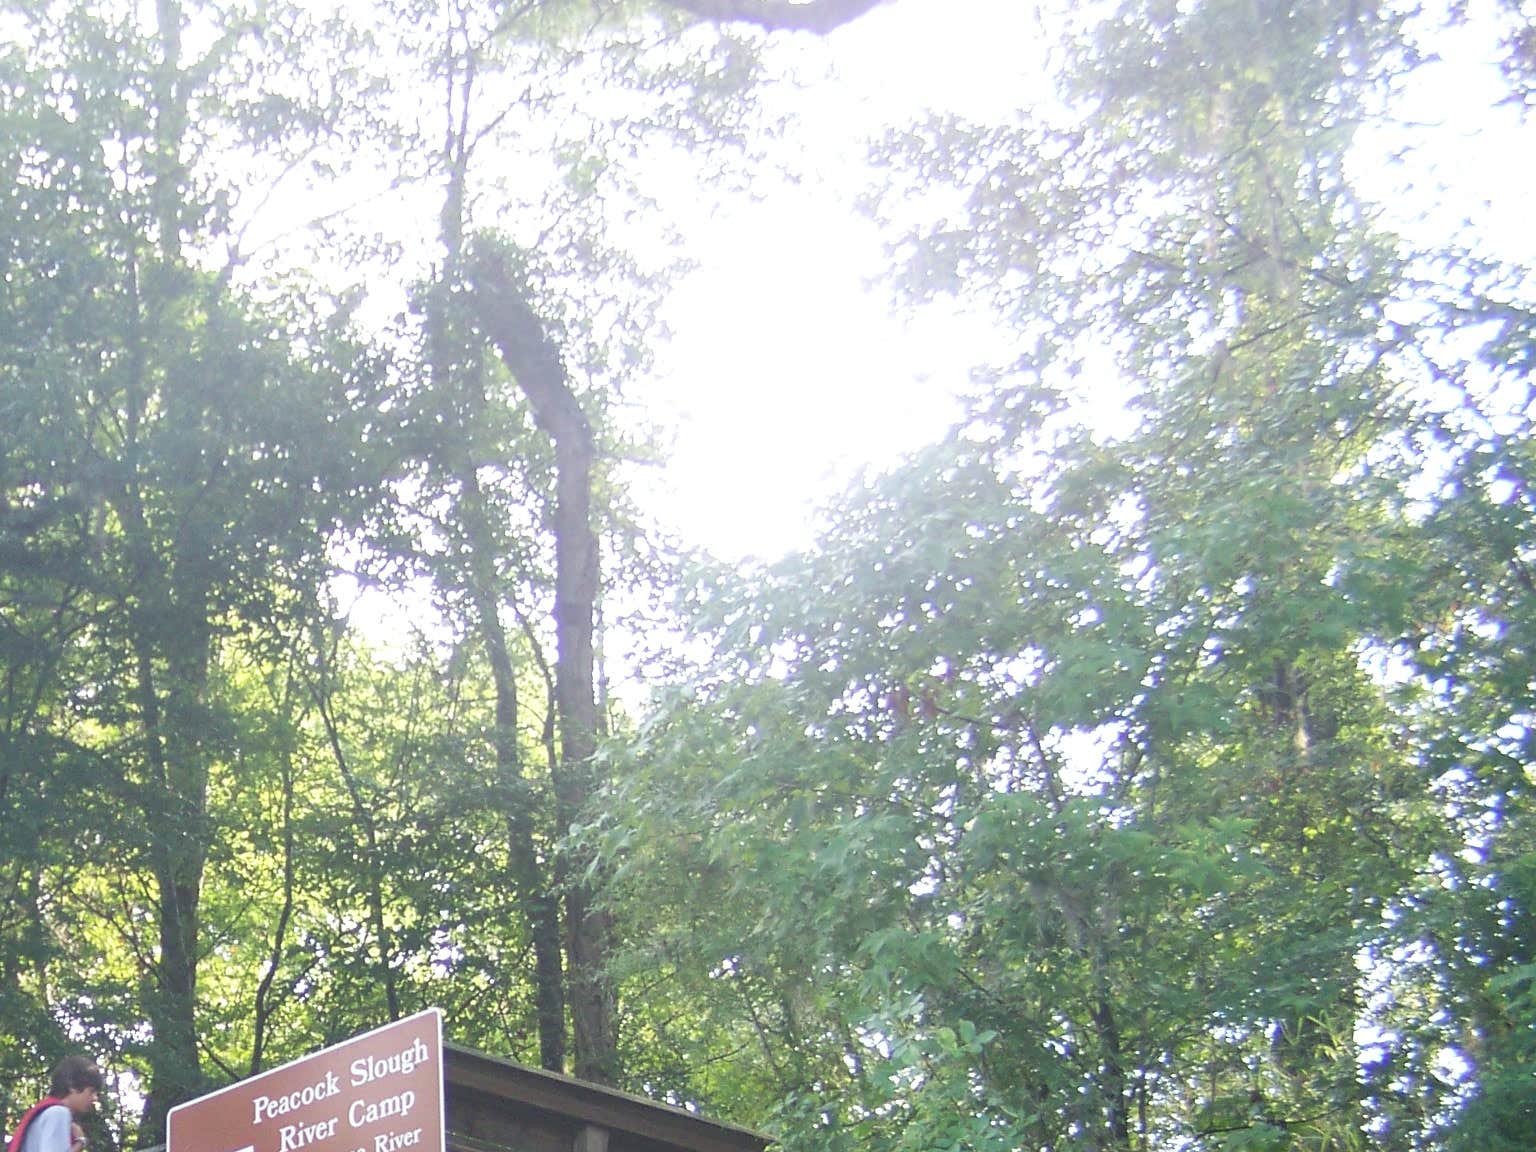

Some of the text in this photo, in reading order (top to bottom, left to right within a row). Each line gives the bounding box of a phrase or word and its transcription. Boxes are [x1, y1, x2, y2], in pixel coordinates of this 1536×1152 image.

[252, 1037, 430, 1125] Peacock Slough
[348, 1090, 416, 1128] Camp
